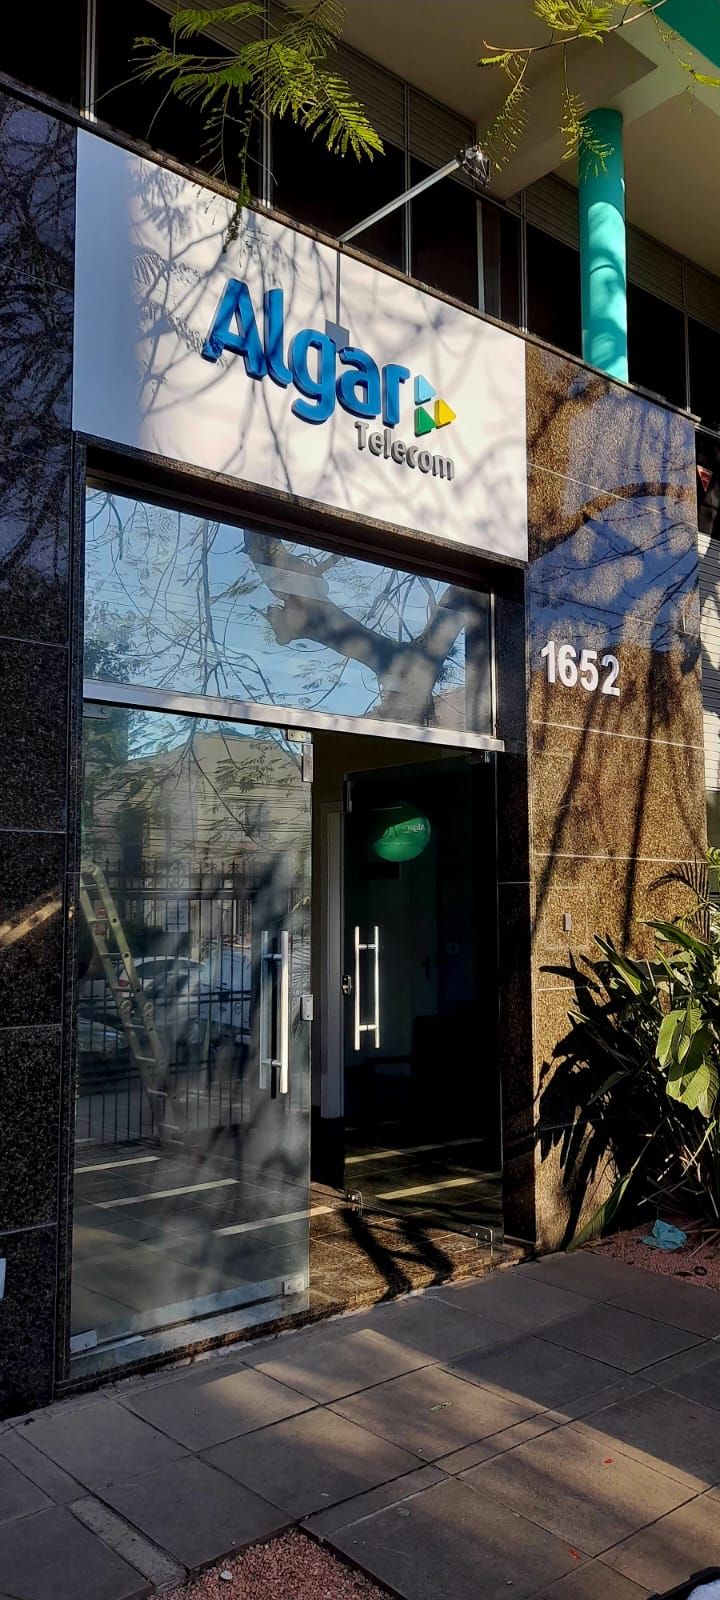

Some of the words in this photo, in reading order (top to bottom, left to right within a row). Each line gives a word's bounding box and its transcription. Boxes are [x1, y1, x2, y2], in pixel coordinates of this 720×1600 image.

[201, 277, 411, 429] Algar
[354, 421, 455, 481] Telecom
[540, 640, 620, 697] 1652
